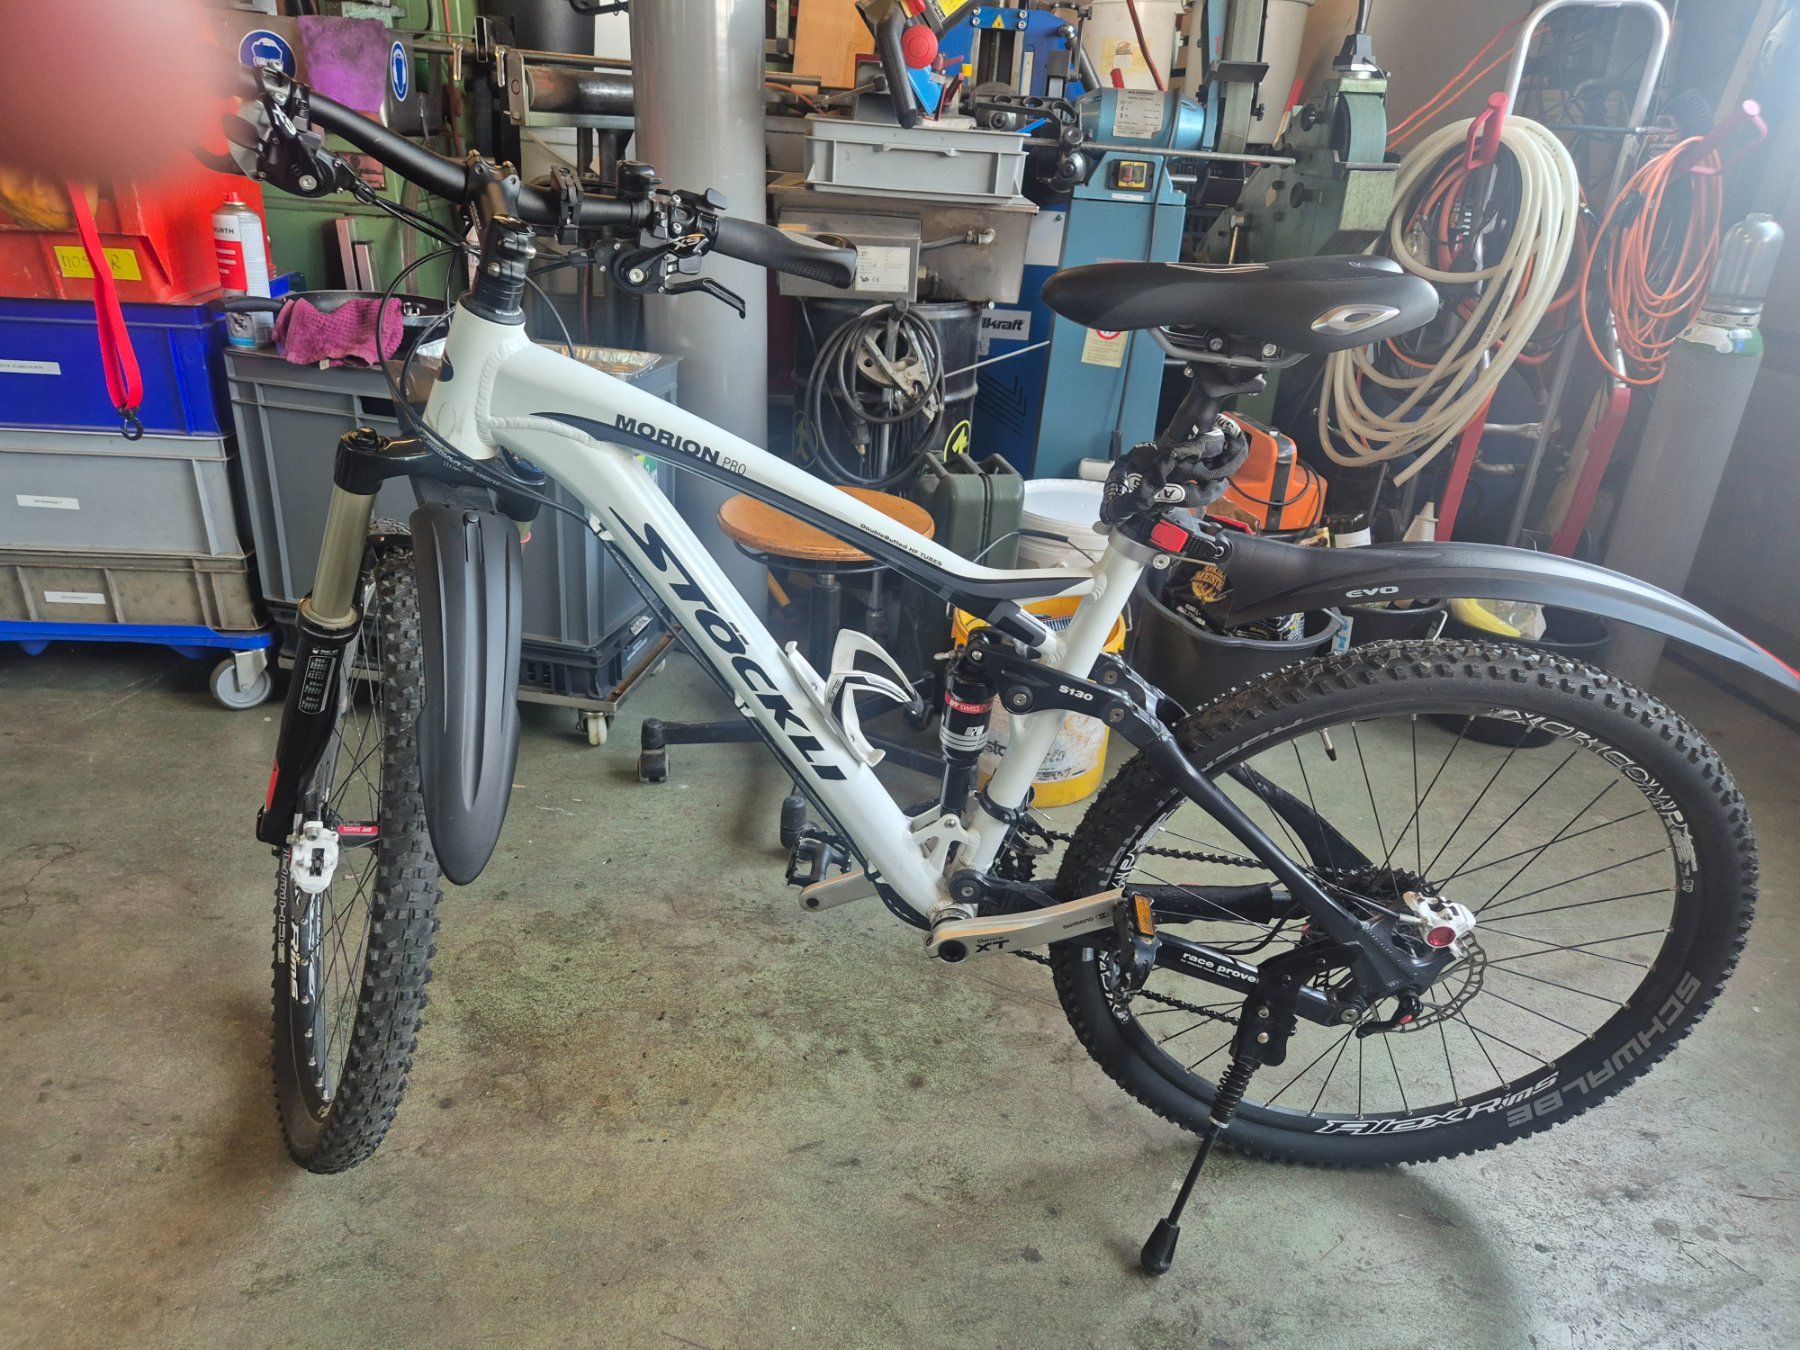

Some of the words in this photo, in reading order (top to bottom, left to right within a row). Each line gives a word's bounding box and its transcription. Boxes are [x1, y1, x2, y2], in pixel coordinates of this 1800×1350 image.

[615, 413, 720, 464] MORION
[721, 456, 747, 476] PRO
[608, 506, 847, 780] STÖCKLI
[1059, 684, 1094, 701] S130
[975, 939, 1009, 953] XT
[1182, 952, 1215, 969] race
[1506, 970, 1702, 1128] SCHWALBE
